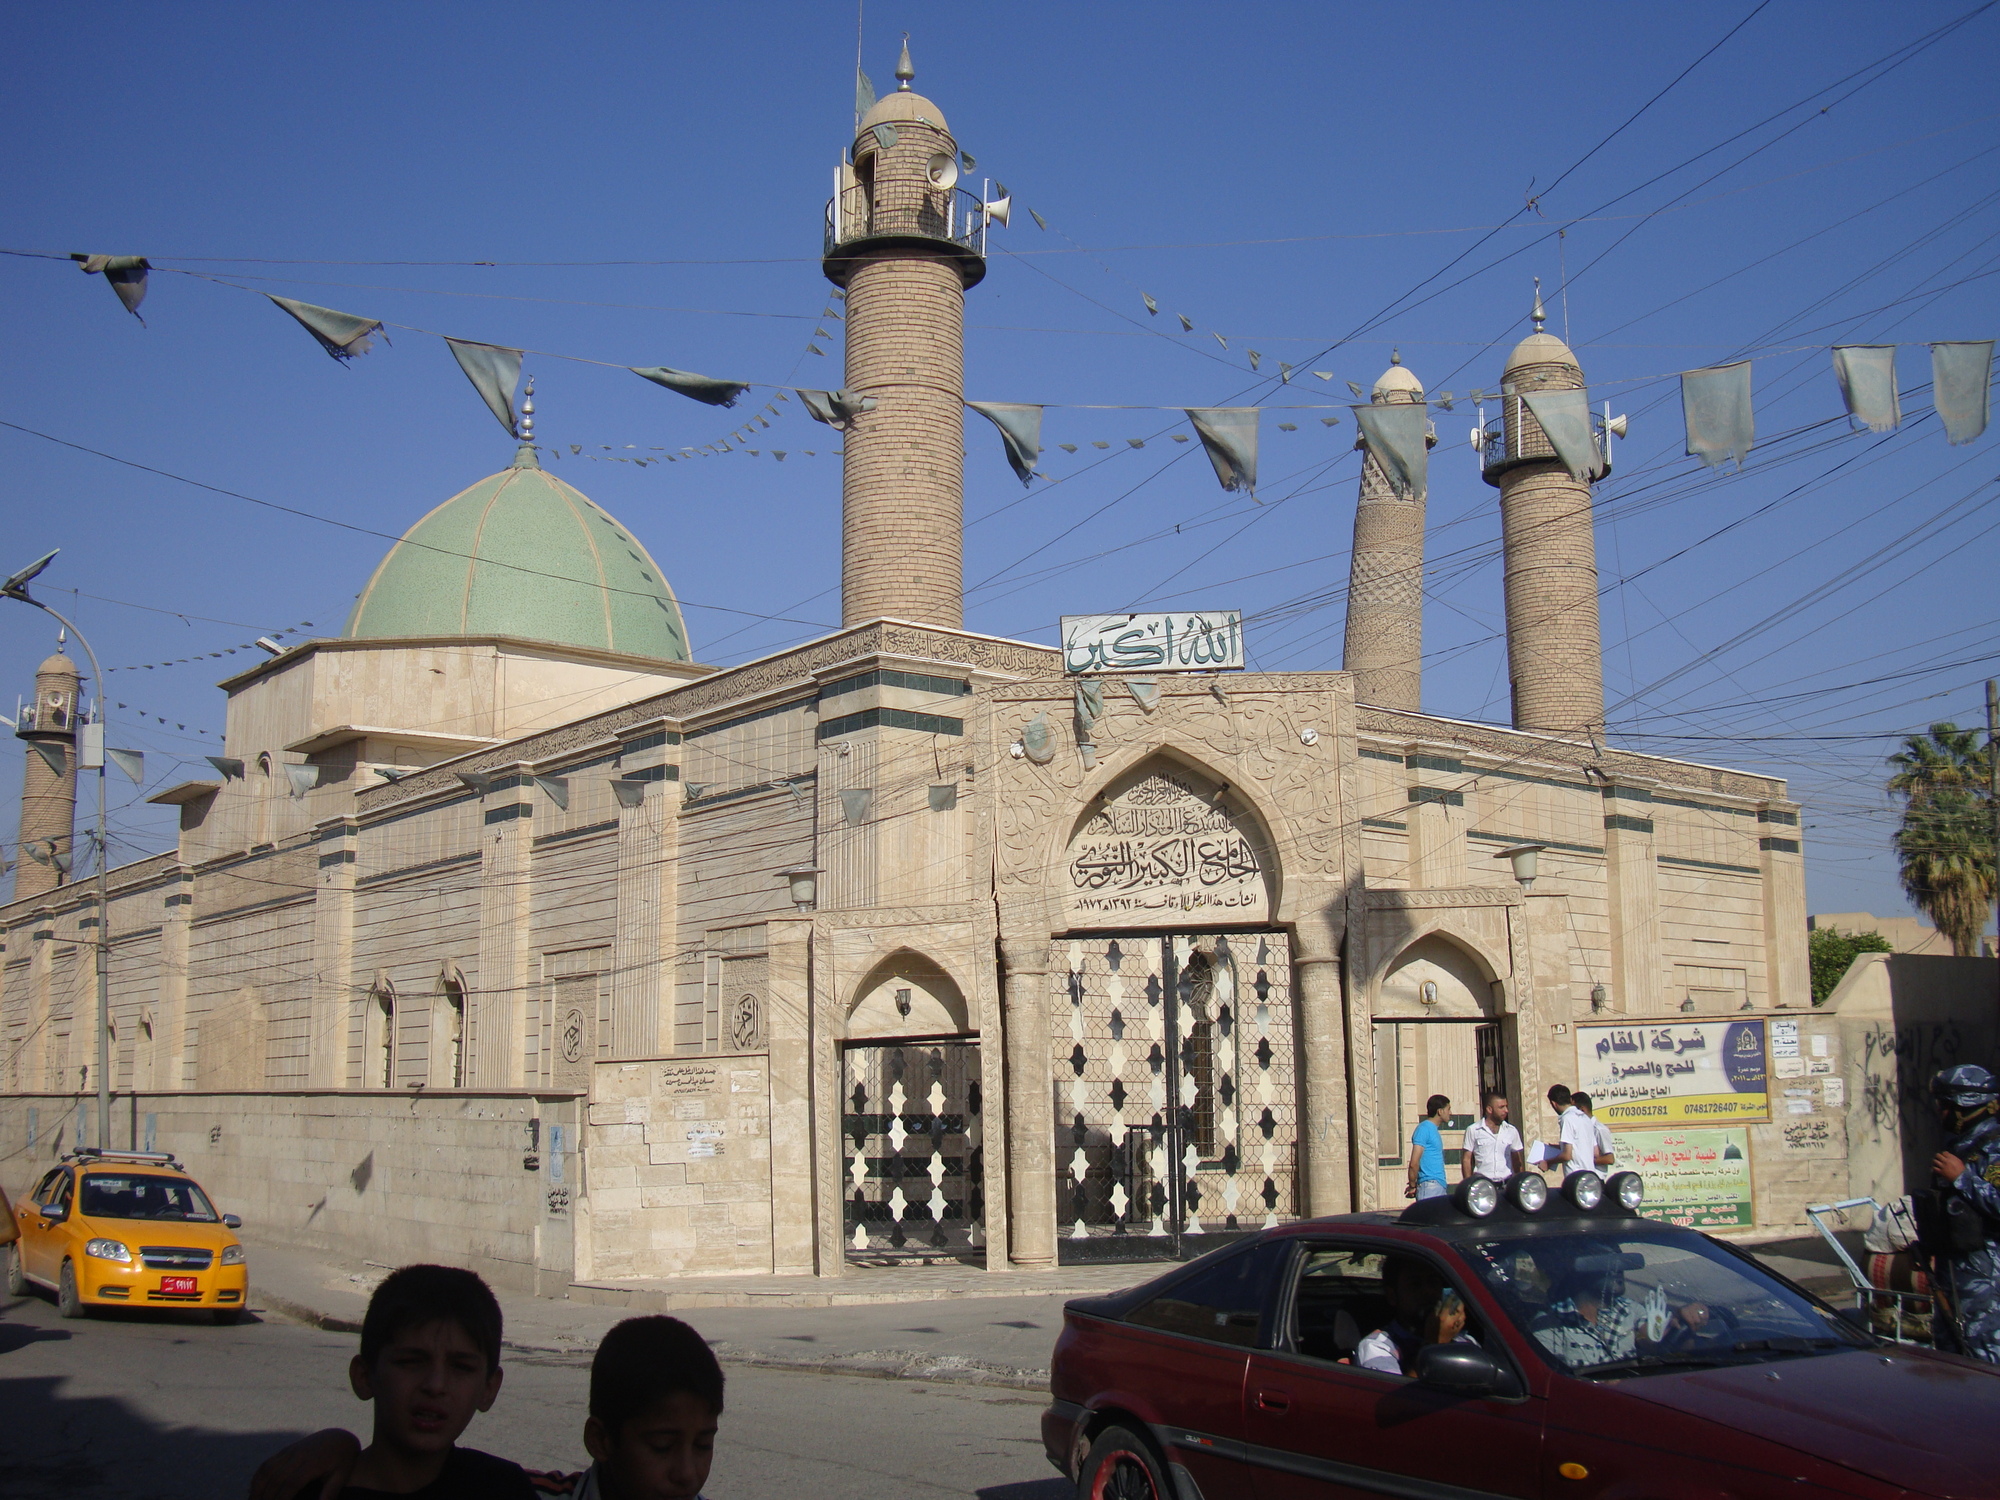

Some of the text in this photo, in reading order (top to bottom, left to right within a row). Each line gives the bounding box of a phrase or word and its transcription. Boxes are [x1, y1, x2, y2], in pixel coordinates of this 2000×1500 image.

[1178, 613, 1238, 665] الله
[1595, 1028, 1706, 1060] شركة المقام
[1611, 1059, 1696, 1080] للحج والعمرة
[1610, 1086, 1629, 1101] غانم
[1629, 1086, 1649, 1099] طارق
[1650, 1086, 1671, 1099] الحاج
[1609, 1105, 1668, 1117] 07703051781
[1663, 1134, 1686, 1147] شركة
[1635, 1146, 1717, 1167] طيبة للحج والعمرة
[1670, 1216, 1694, 1226] VIP
